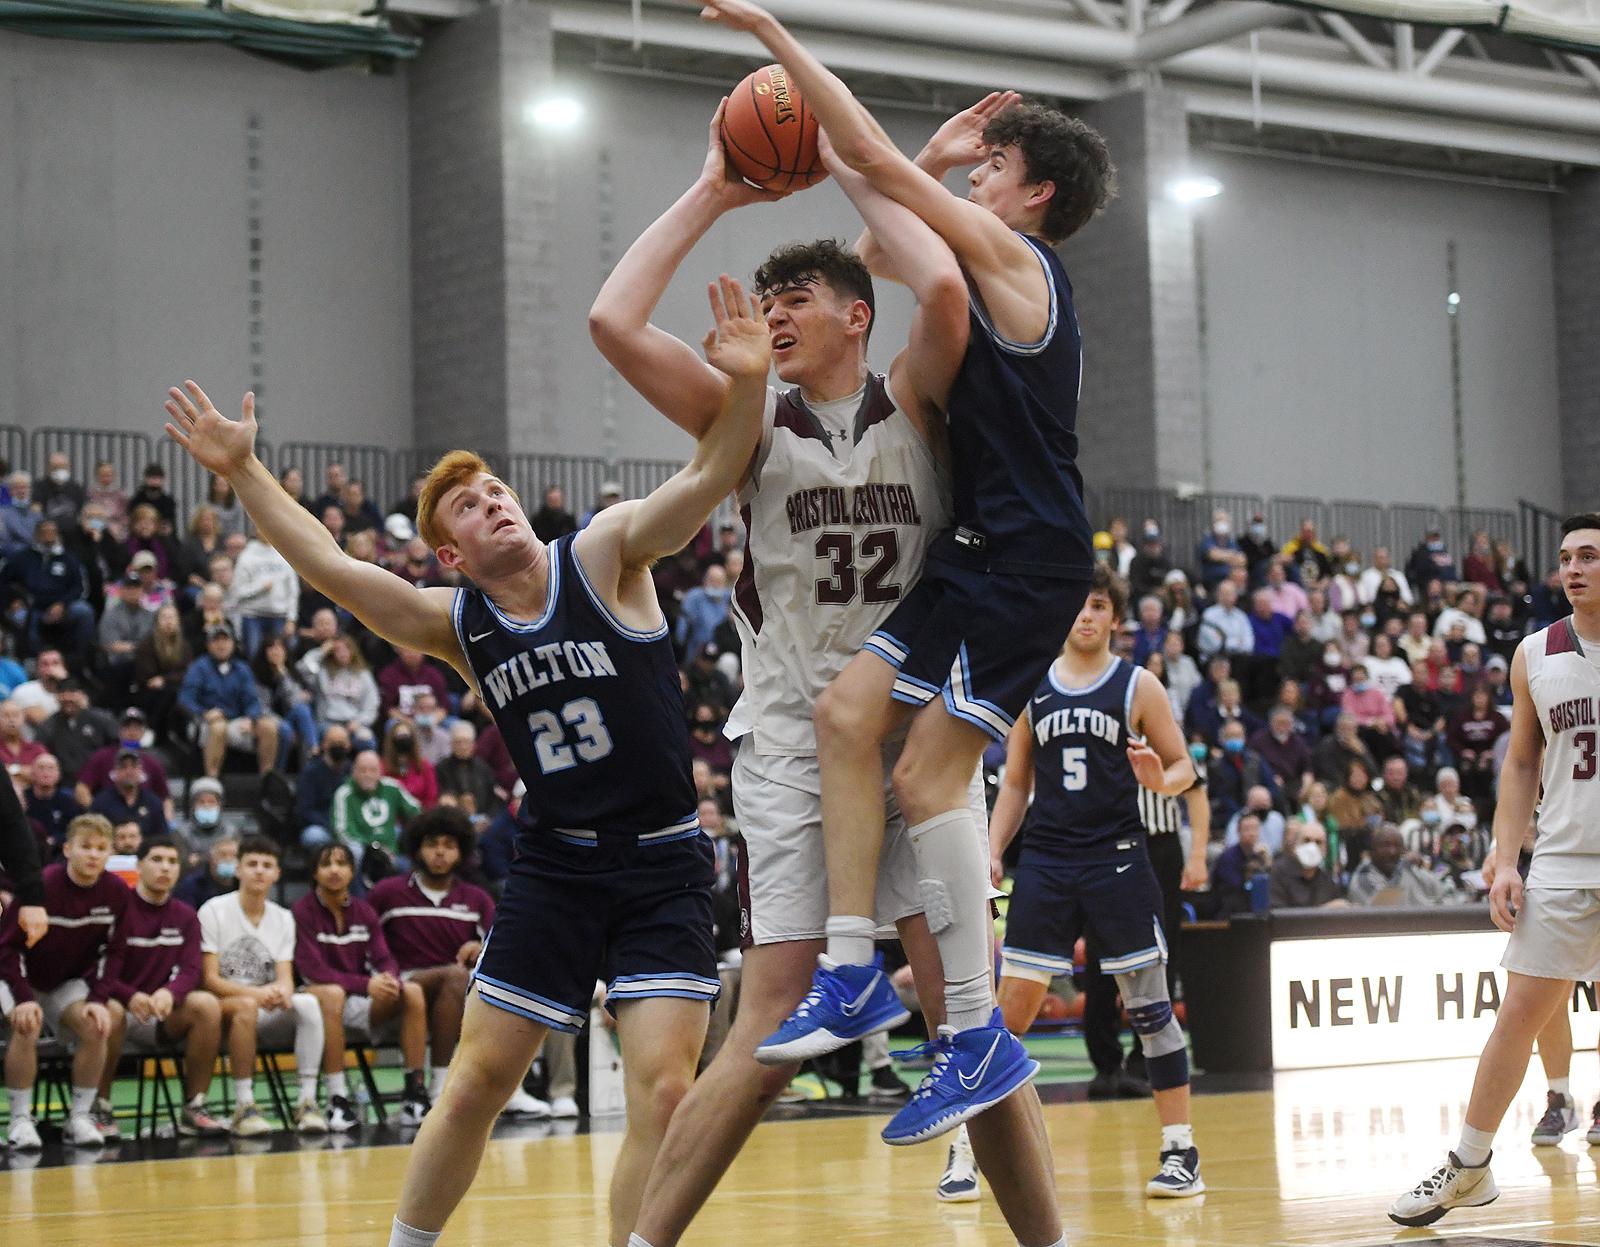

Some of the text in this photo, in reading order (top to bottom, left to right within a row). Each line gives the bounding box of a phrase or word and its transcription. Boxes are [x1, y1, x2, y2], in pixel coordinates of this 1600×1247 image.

[786, 483, 921, 535] BRISTOL CENTRAL
[815, 528, 902, 606] 32
[484, 640, 619, 710] WILTON
[527, 696, 614, 776] 23
[1034, 707, 1121, 748] WILTON
[1549, 697, 1596, 735] BRISTOL
[1062, 747, 1088, 792] 5
[1289, 971, 1599, 1029] NEW HAN
